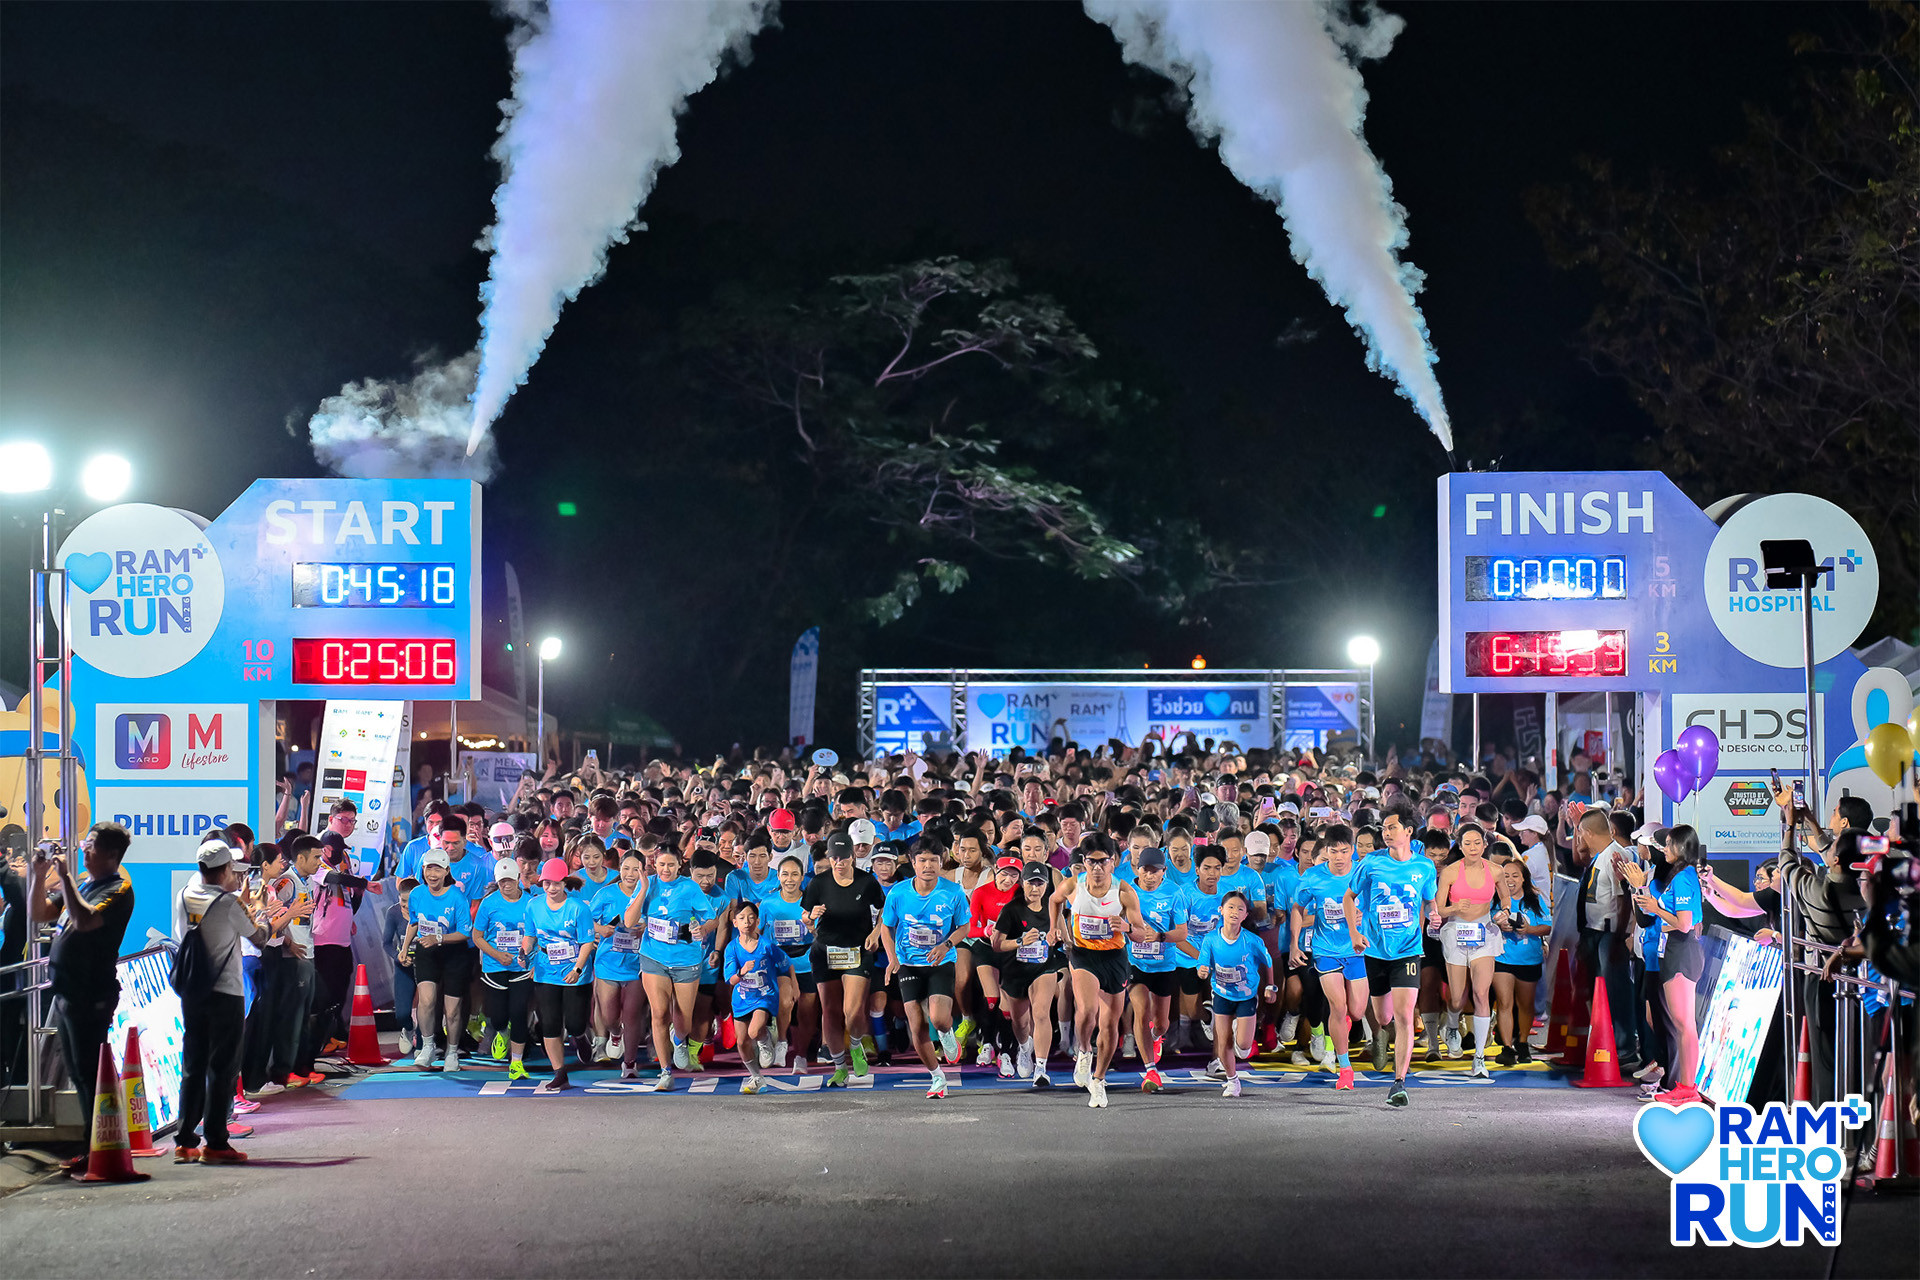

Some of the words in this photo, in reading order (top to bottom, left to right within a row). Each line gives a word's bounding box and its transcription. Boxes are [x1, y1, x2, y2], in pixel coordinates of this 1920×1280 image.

[265, 500, 455, 545] START
[1465, 491, 1654, 535] FINISH
[1655, 556, 1670, 577] 5
[116, 574, 194, 598] HERO
[321, 566, 455, 604] 0:45:18
[1649, 584, 1676, 598] KM
[90, 596, 192, 636] RUN
[242, 638, 275, 661] 10
[1656, 632, 1670, 652] 3
[322, 642, 454, 680] 0:25:06
[1649, 660, 1677, 673] KM
[244, 667, 272, 682] KM
[1230, 701, 1254, 715] คน
[128, 720, 160, 754] M
[188, 713, 222, 750] M
[992, 722, 1048, 744] RUN
[1727, 744, 1766, 753] DESIGN
[1768, 744, 1788, 754] CO.,
[181, 751, 229, 770] Lifestore
[495, 758, 532, 768] MEDL
[1728, 798, 1770, 806] SYNNEX
[1406, 962, 1416, 976] 10
